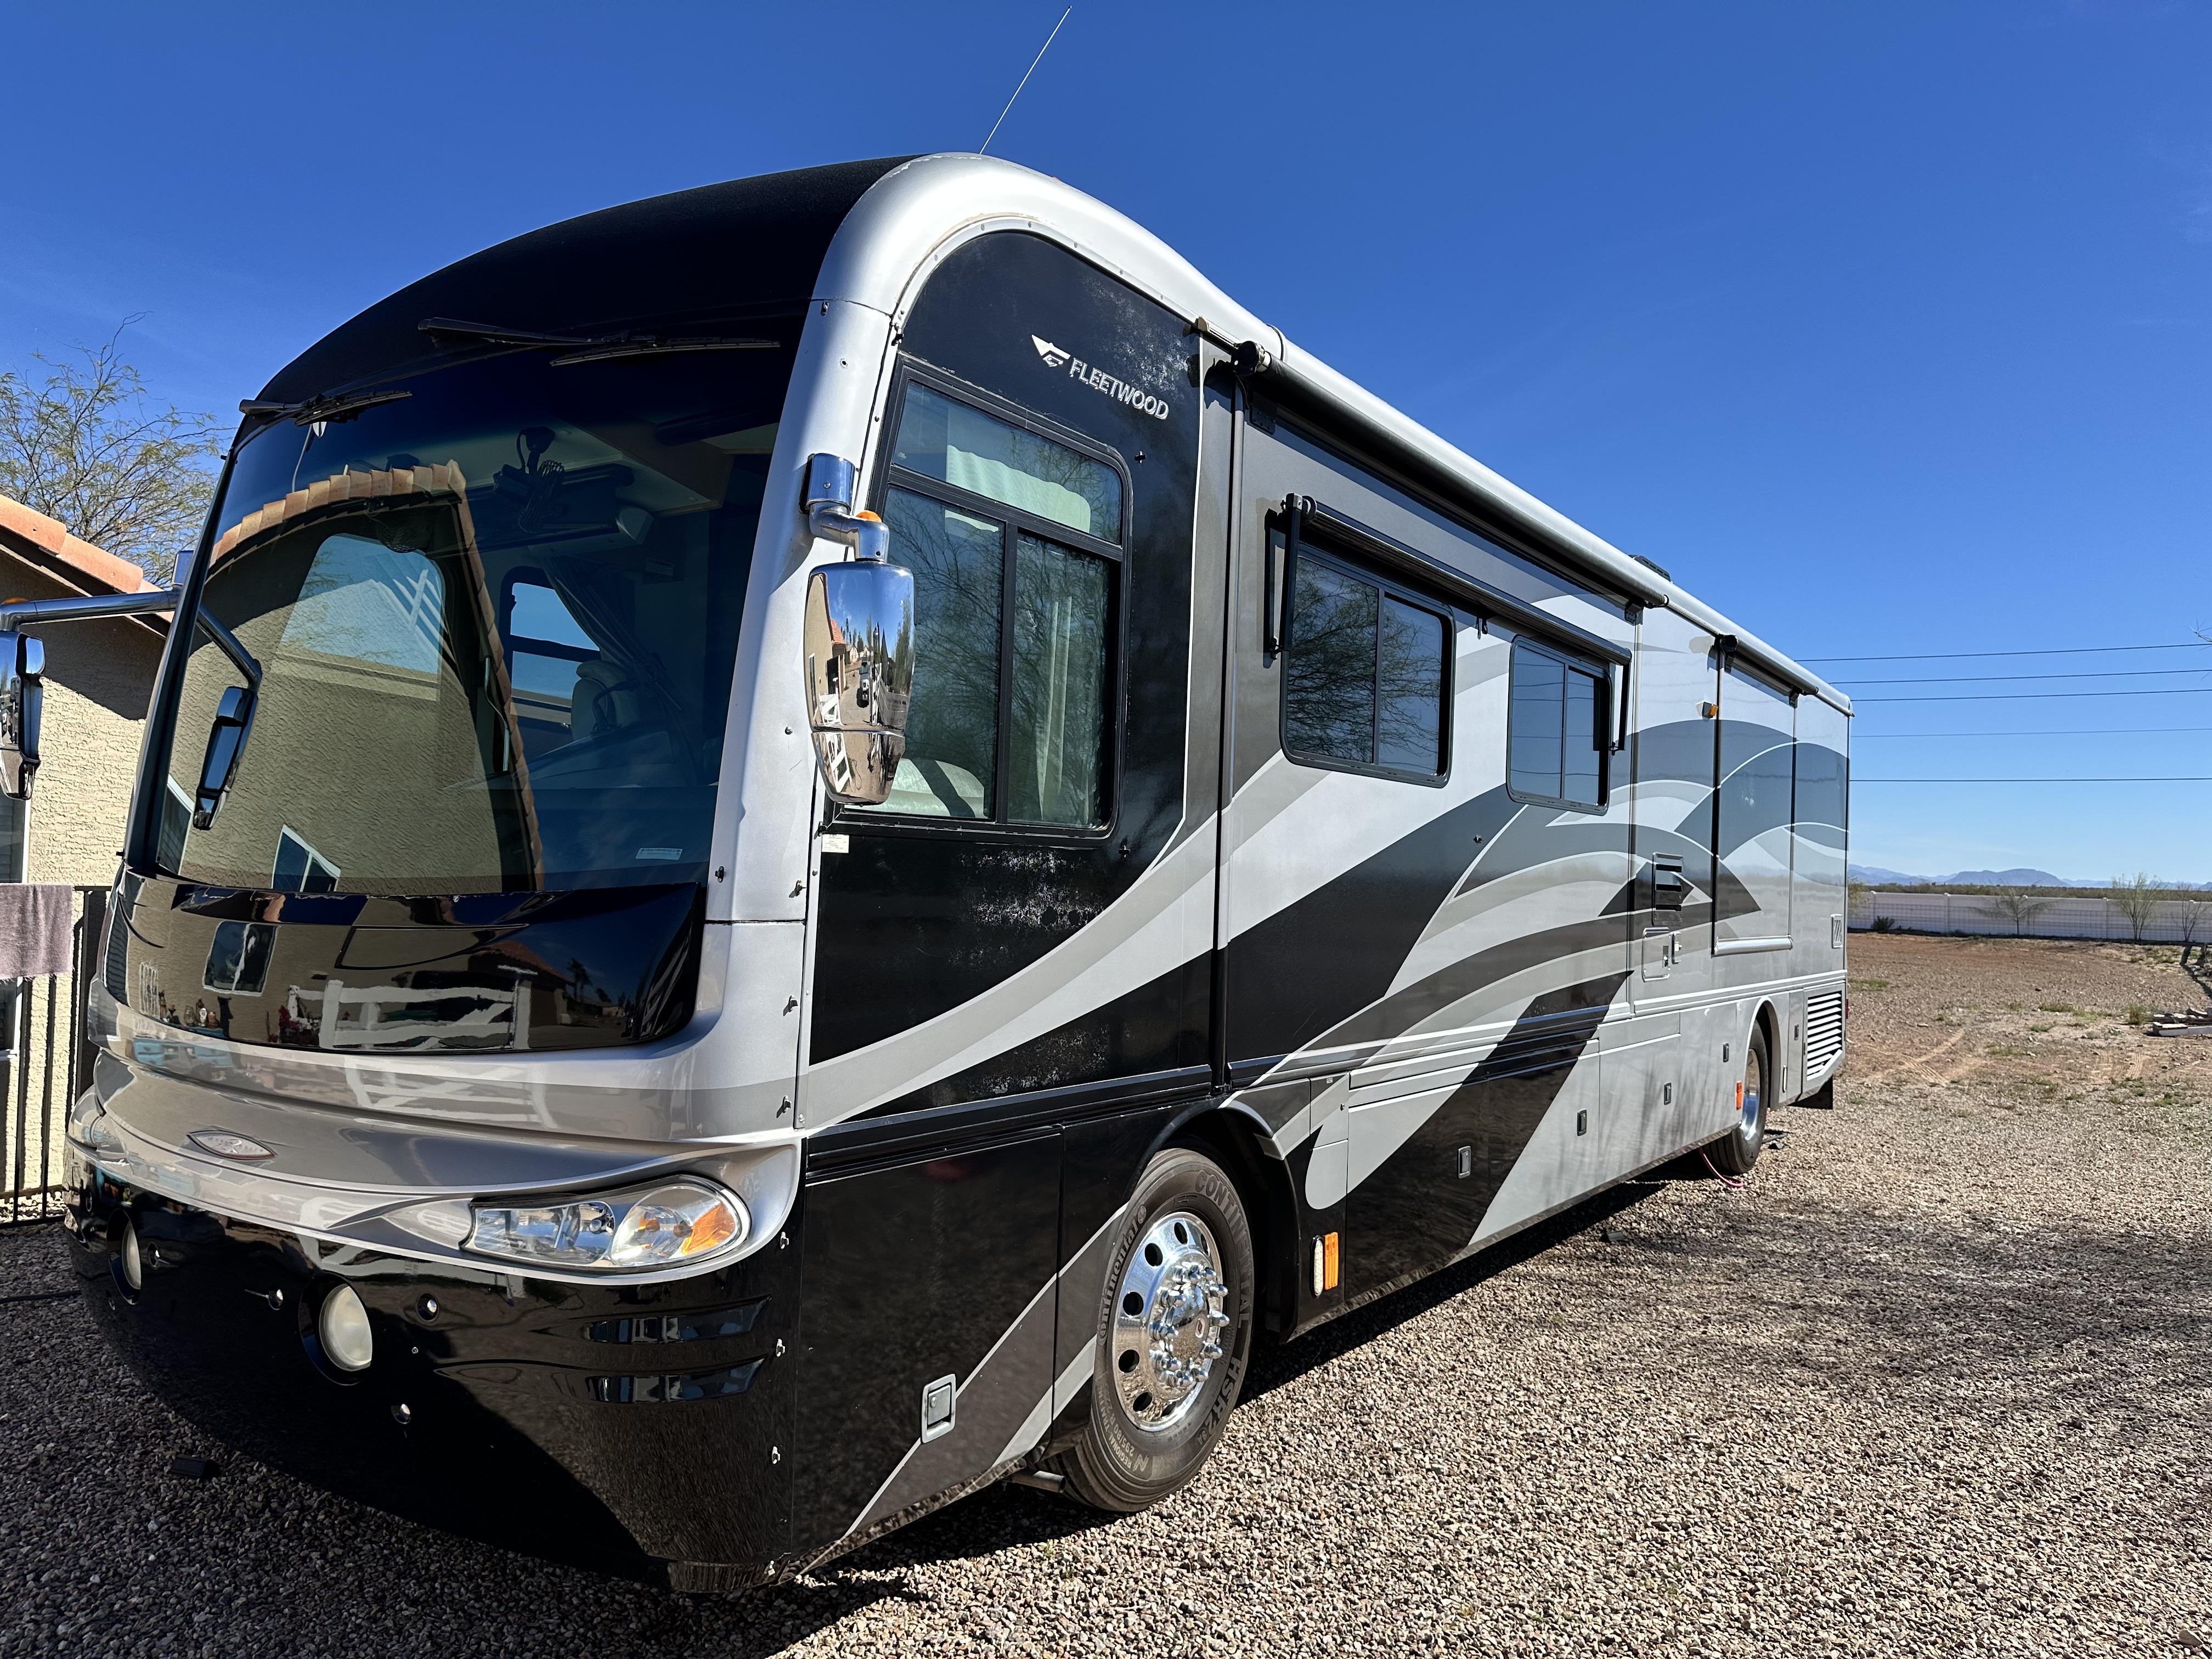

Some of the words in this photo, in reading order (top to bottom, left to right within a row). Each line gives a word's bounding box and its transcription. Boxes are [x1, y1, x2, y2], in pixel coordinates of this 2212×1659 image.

[1069, 358, 1169, 420] FLEETWOOD
[1195, 1170, 1251, 1328] CONTINENTAL
[1205, 1357, 1242, 1435] HSR2
[1113, 1424, 1135, 1457] 295/80
